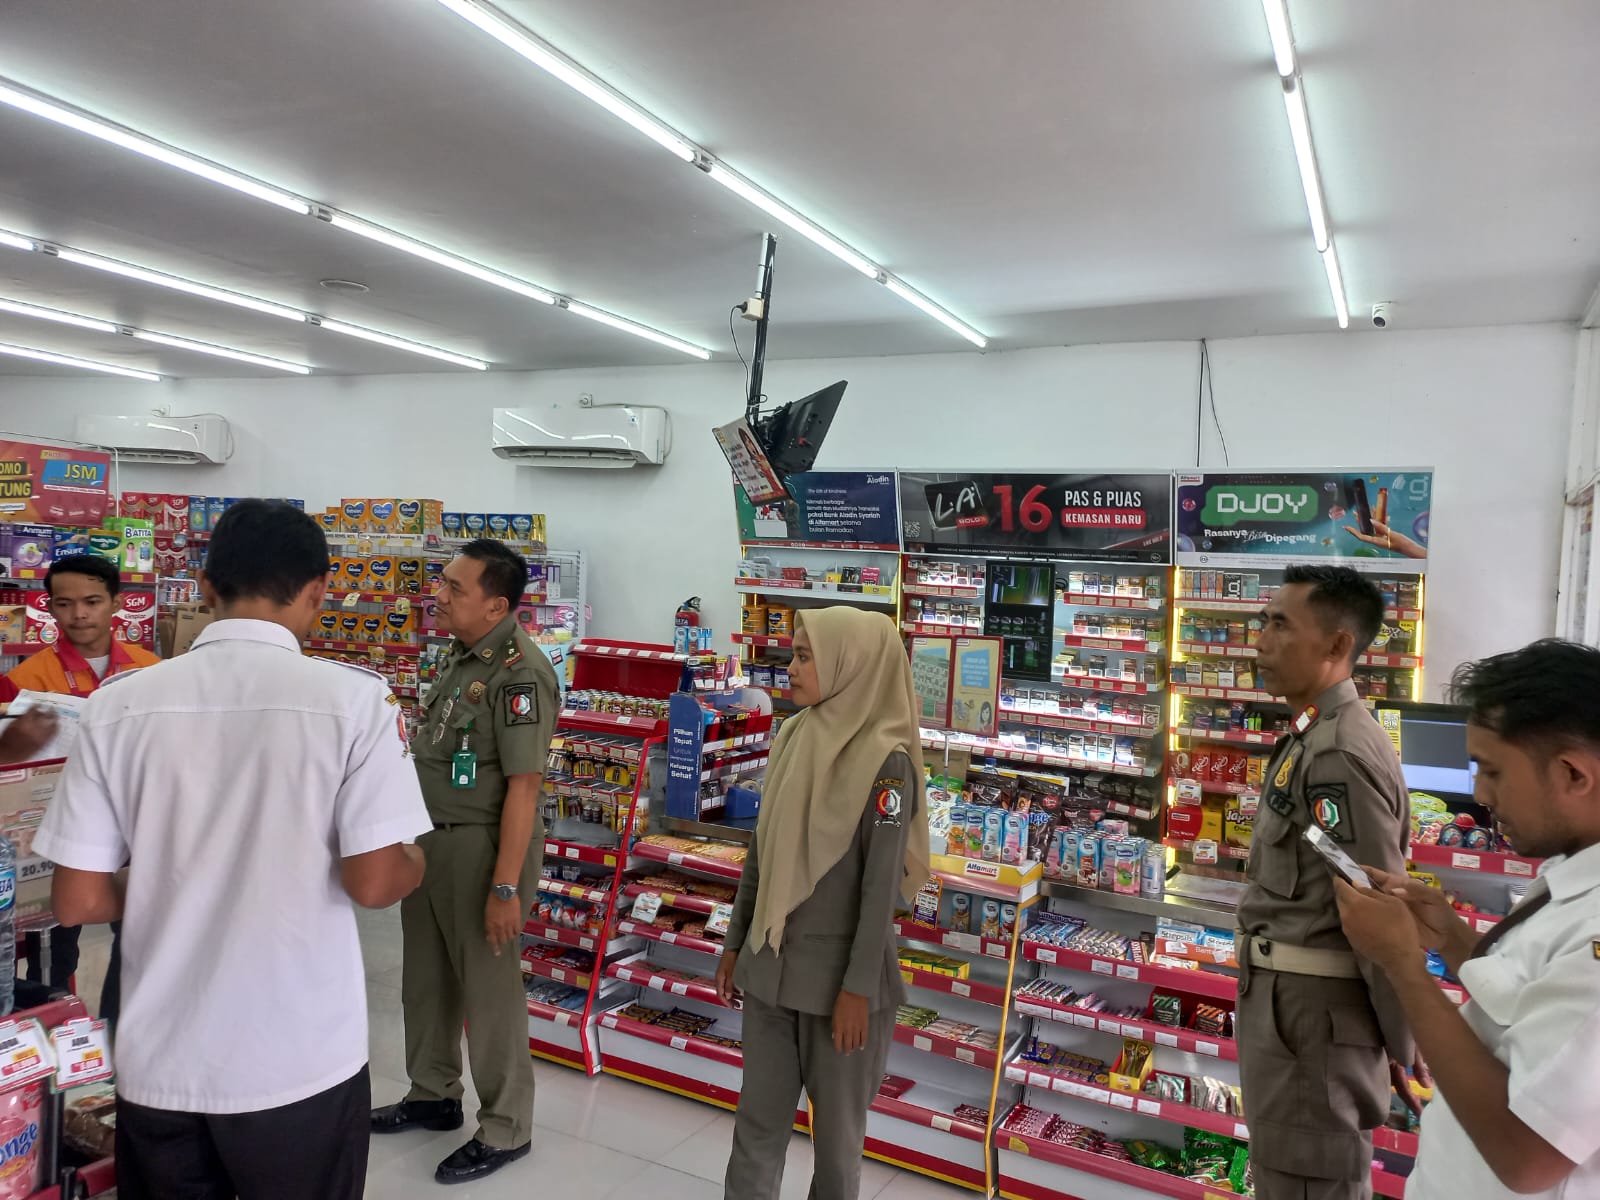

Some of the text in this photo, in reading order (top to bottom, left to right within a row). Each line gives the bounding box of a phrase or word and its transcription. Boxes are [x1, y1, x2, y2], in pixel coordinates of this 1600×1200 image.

[64, 463, 97, 480] JSM
[1065, 490, 1142, 507] PAS & PUAS
[1217, 493, 1307, 514] DJOY
[993, 485, 1053, 532] 16
[1065, 513, 1142, 525] KEMASAN BARU
[1204, 529, 1248, 539] Rasanya
[1265, 534, 1317, 544] Dipegang
[55, 547, 84, 557] Ensure
[126, 597, 146, 608] SGM
[673, 728, 694, 736] Pilihan
[673, 736, 693, 745] Tepat
[669, 762, 694, 772] Keluarga
[671, 770, 692, 780] Sehat
[967, 863, 998, 874] Alfamart
[1161, 930, 1193, 942] Strepsils
[1131, 941, 1143, 964] OPIKO
